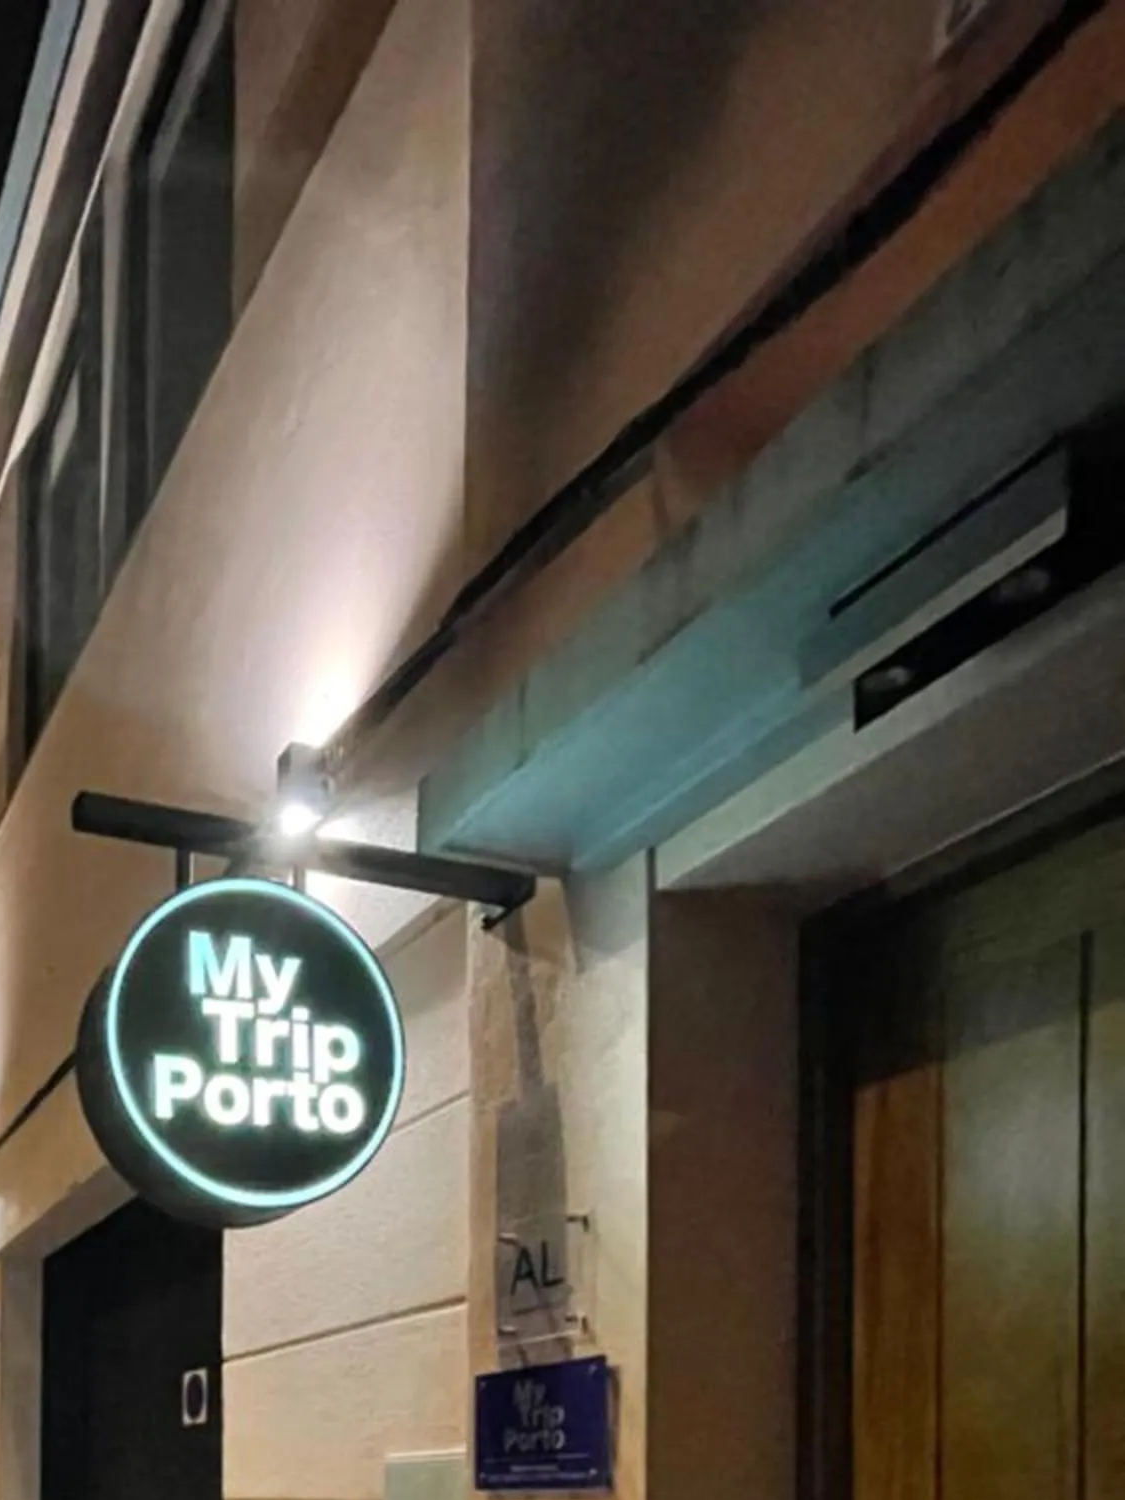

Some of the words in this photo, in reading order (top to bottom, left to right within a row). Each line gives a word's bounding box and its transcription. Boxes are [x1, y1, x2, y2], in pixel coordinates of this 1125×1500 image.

[188, 930, 301, 1016] My
[201, 998, 360, 1084] Trip
[153, 1053, 366, 1133] Porto
[510, 1239, 564, 1297] AL
